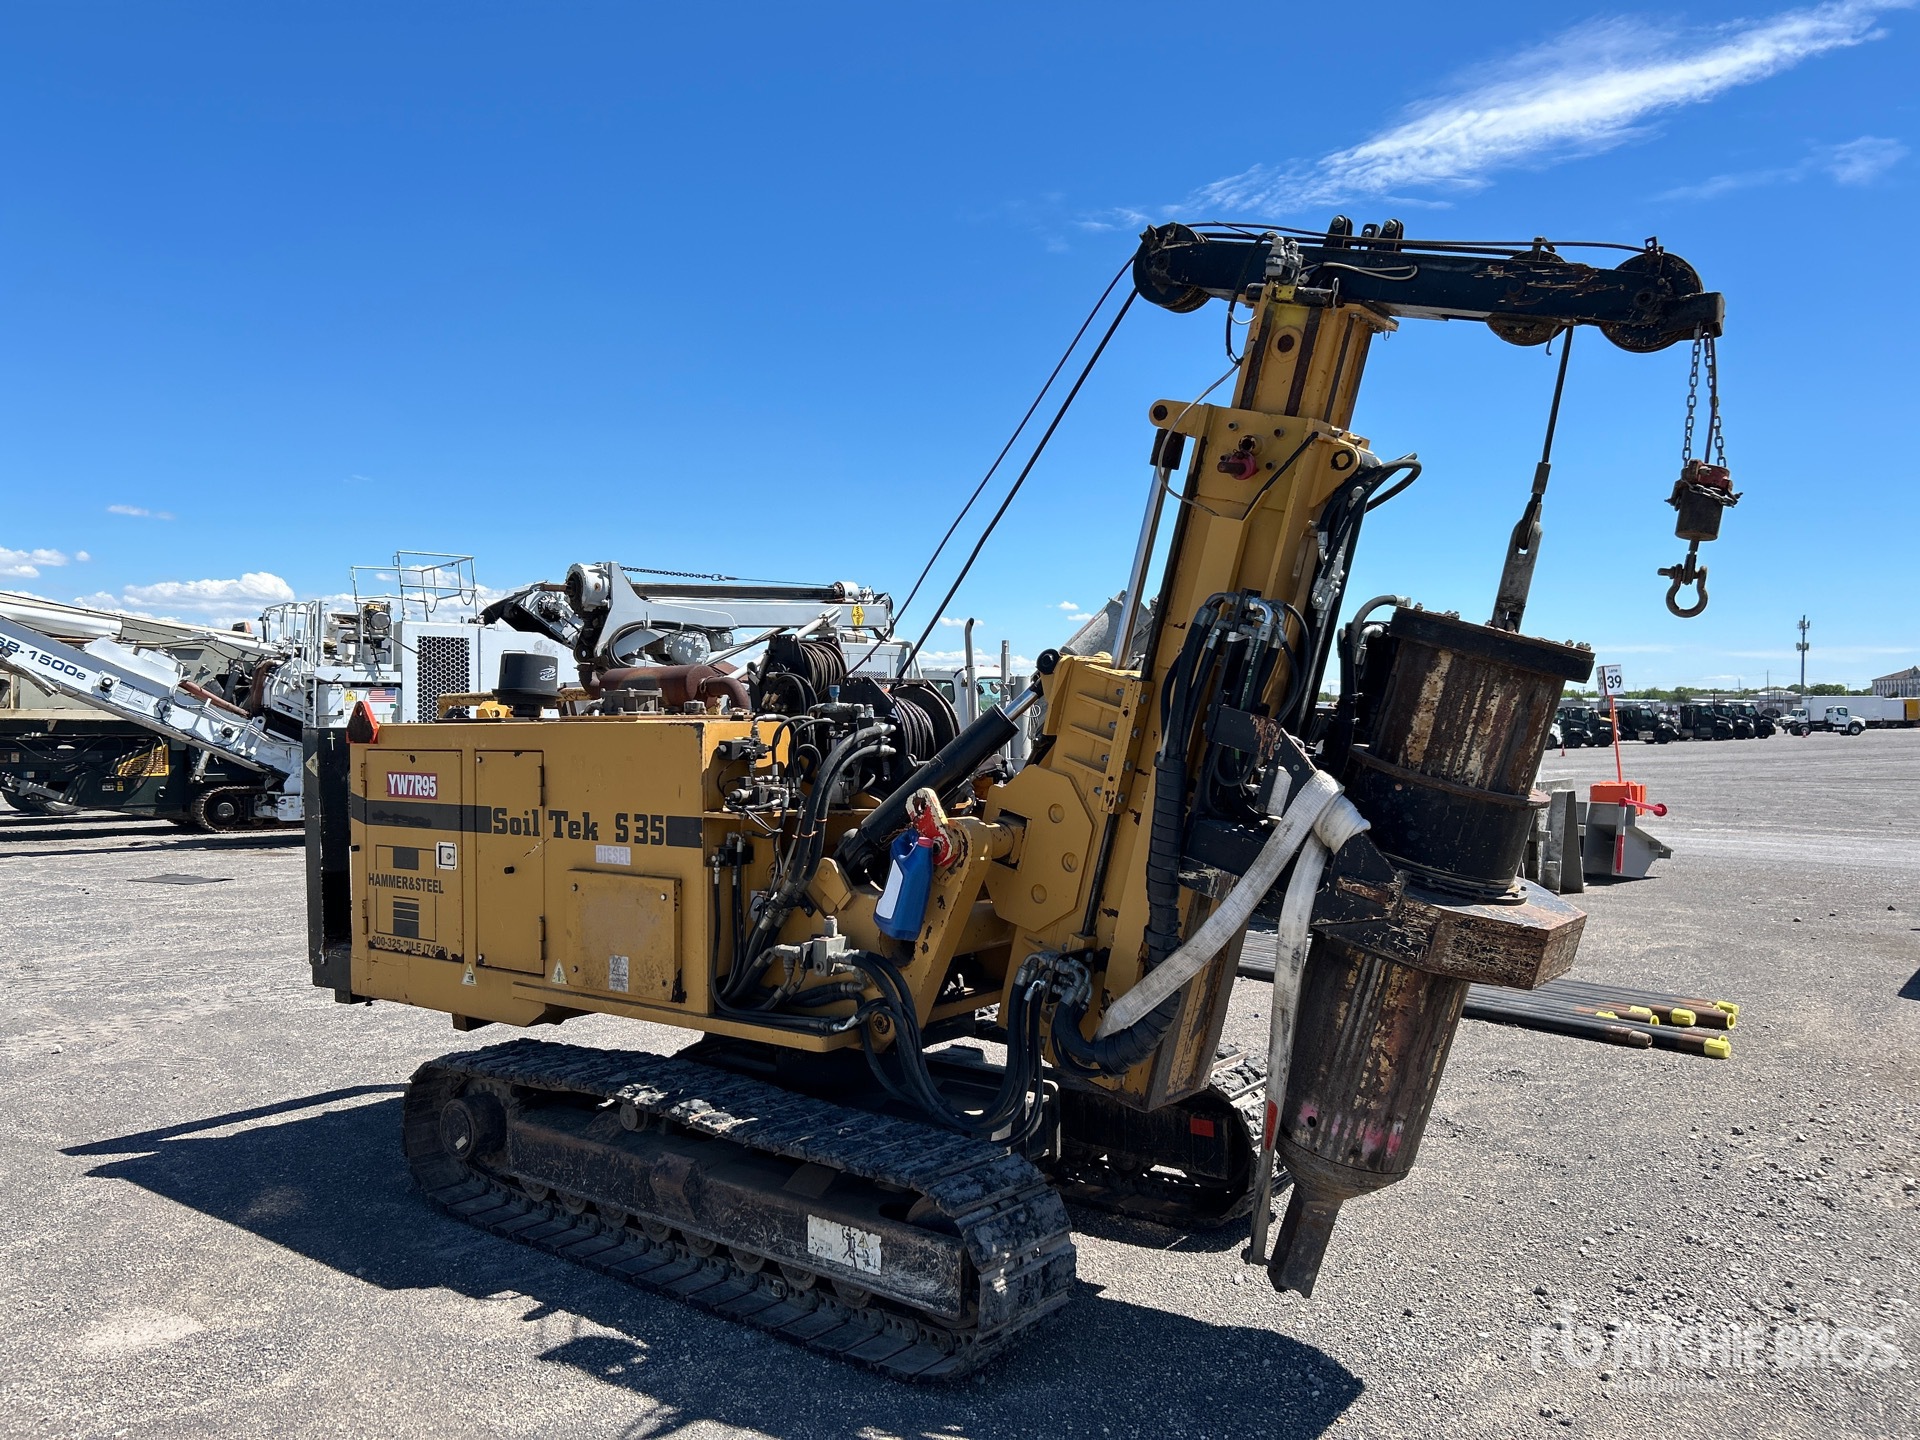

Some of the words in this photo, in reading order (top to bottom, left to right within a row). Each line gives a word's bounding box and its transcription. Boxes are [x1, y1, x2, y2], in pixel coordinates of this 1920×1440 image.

[1607, 675, 1622, 688] 39
[388, 773, 437, 797] YW7R95
[493, 807, 540, 837] Soil
[548, 809, 599, 841] Tek
[597, 846, 631, 865] DIESEL
[368, 872, 444, 894] HAMMER&STEEL
